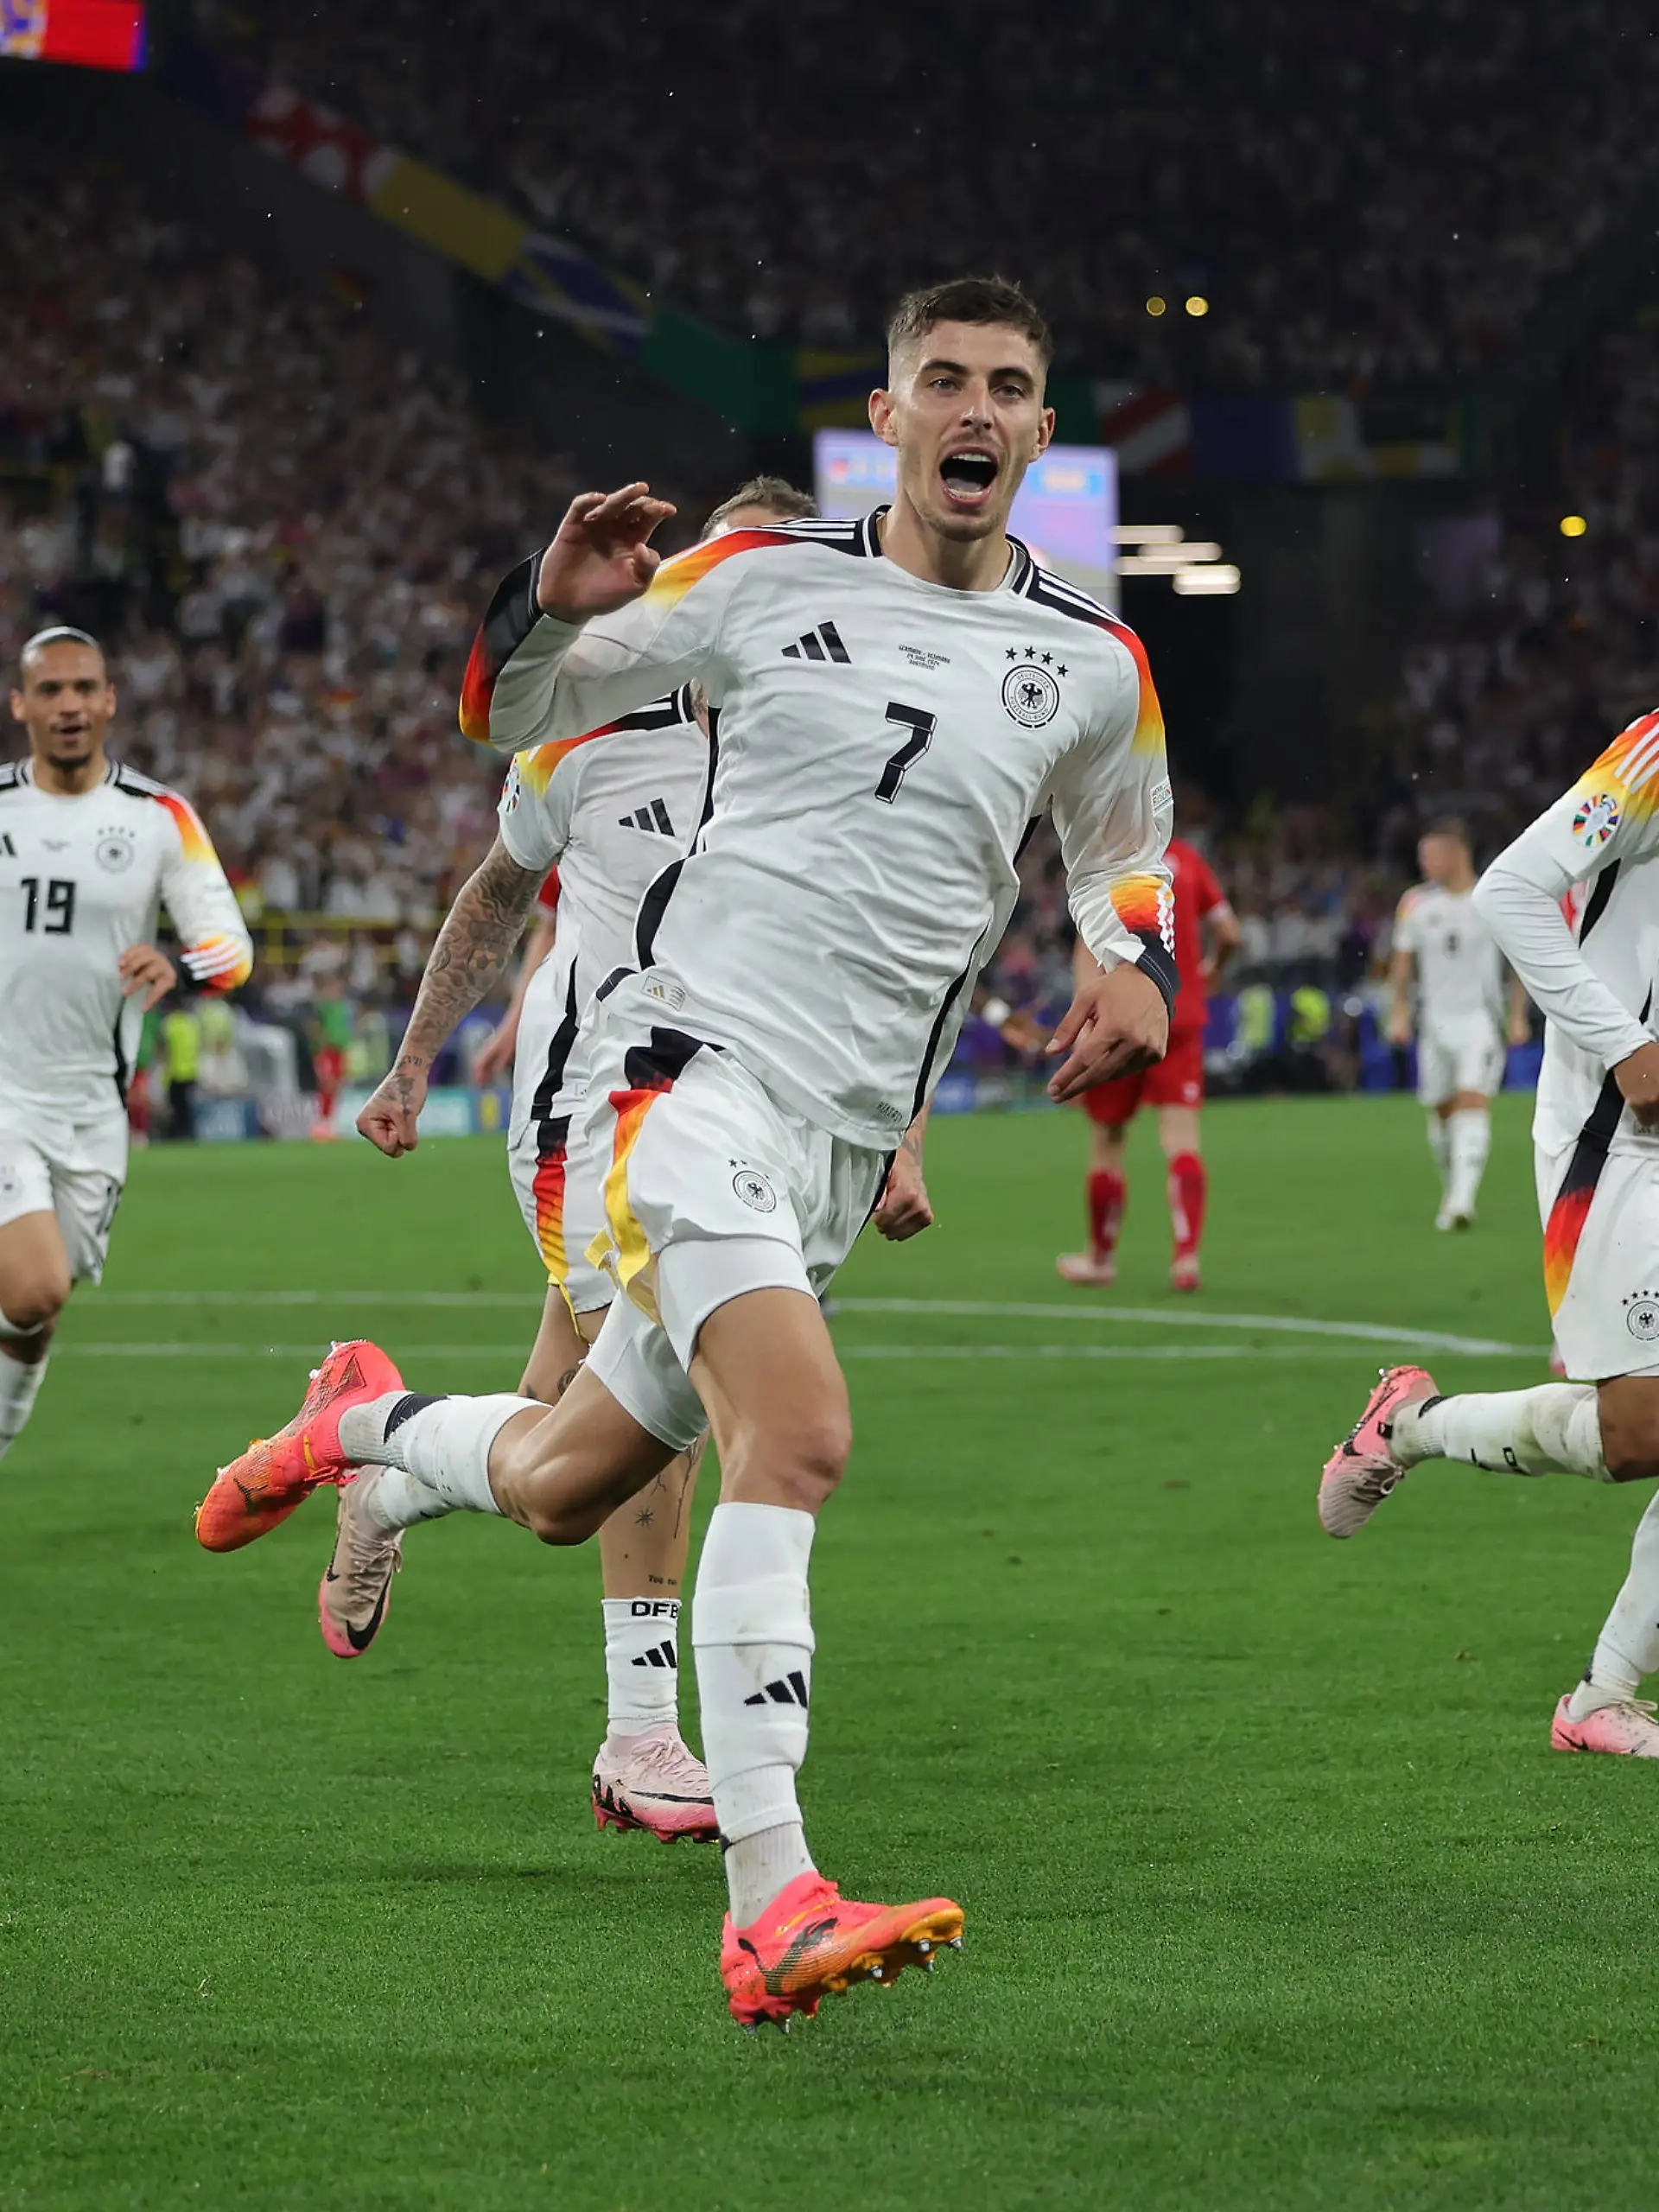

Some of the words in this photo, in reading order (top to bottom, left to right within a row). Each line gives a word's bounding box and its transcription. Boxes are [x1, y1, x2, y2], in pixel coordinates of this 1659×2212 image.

[874, 701, 938, 804] 7
[20, 877, 77, 935] 19
[632, 1601, 678, 1618] DFB
